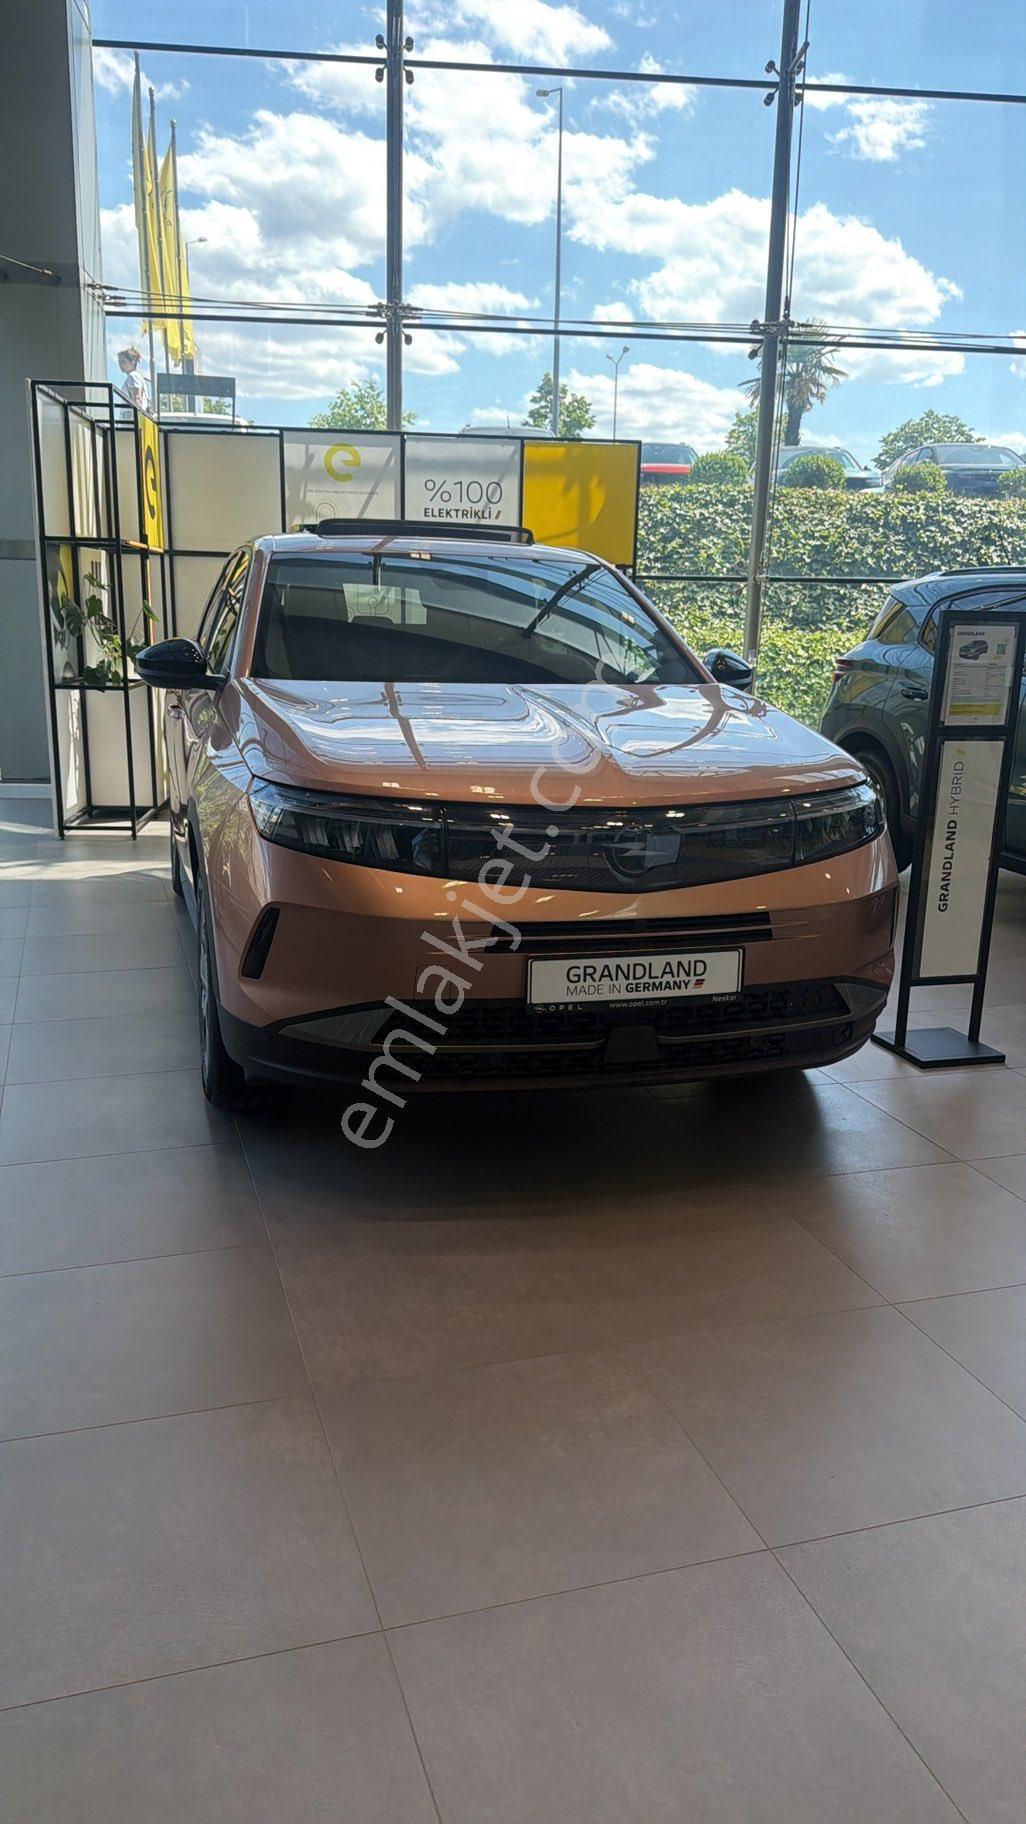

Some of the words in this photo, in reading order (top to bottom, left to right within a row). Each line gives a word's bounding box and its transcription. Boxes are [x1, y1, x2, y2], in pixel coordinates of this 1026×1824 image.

[424, 479, 503, 505] %100
[423, 506, 492, 520] ELEKTRİKLİ
[937, 819, 958, 913] GRANDLAND
[949, 761, 965, 816] HYBRID
[566, 959, 708, 984] GRANDLAND
[566, 984, 605, 997] MADE
[608, 983, 622, 994] IN
[625, 979, 691, 994] GERMANY
[548, 1004, 583, 1012] OPEL
[609, 1000, 668, 1010] www.opel.com.tr
[712, 994, 738, 1003] Neskar
